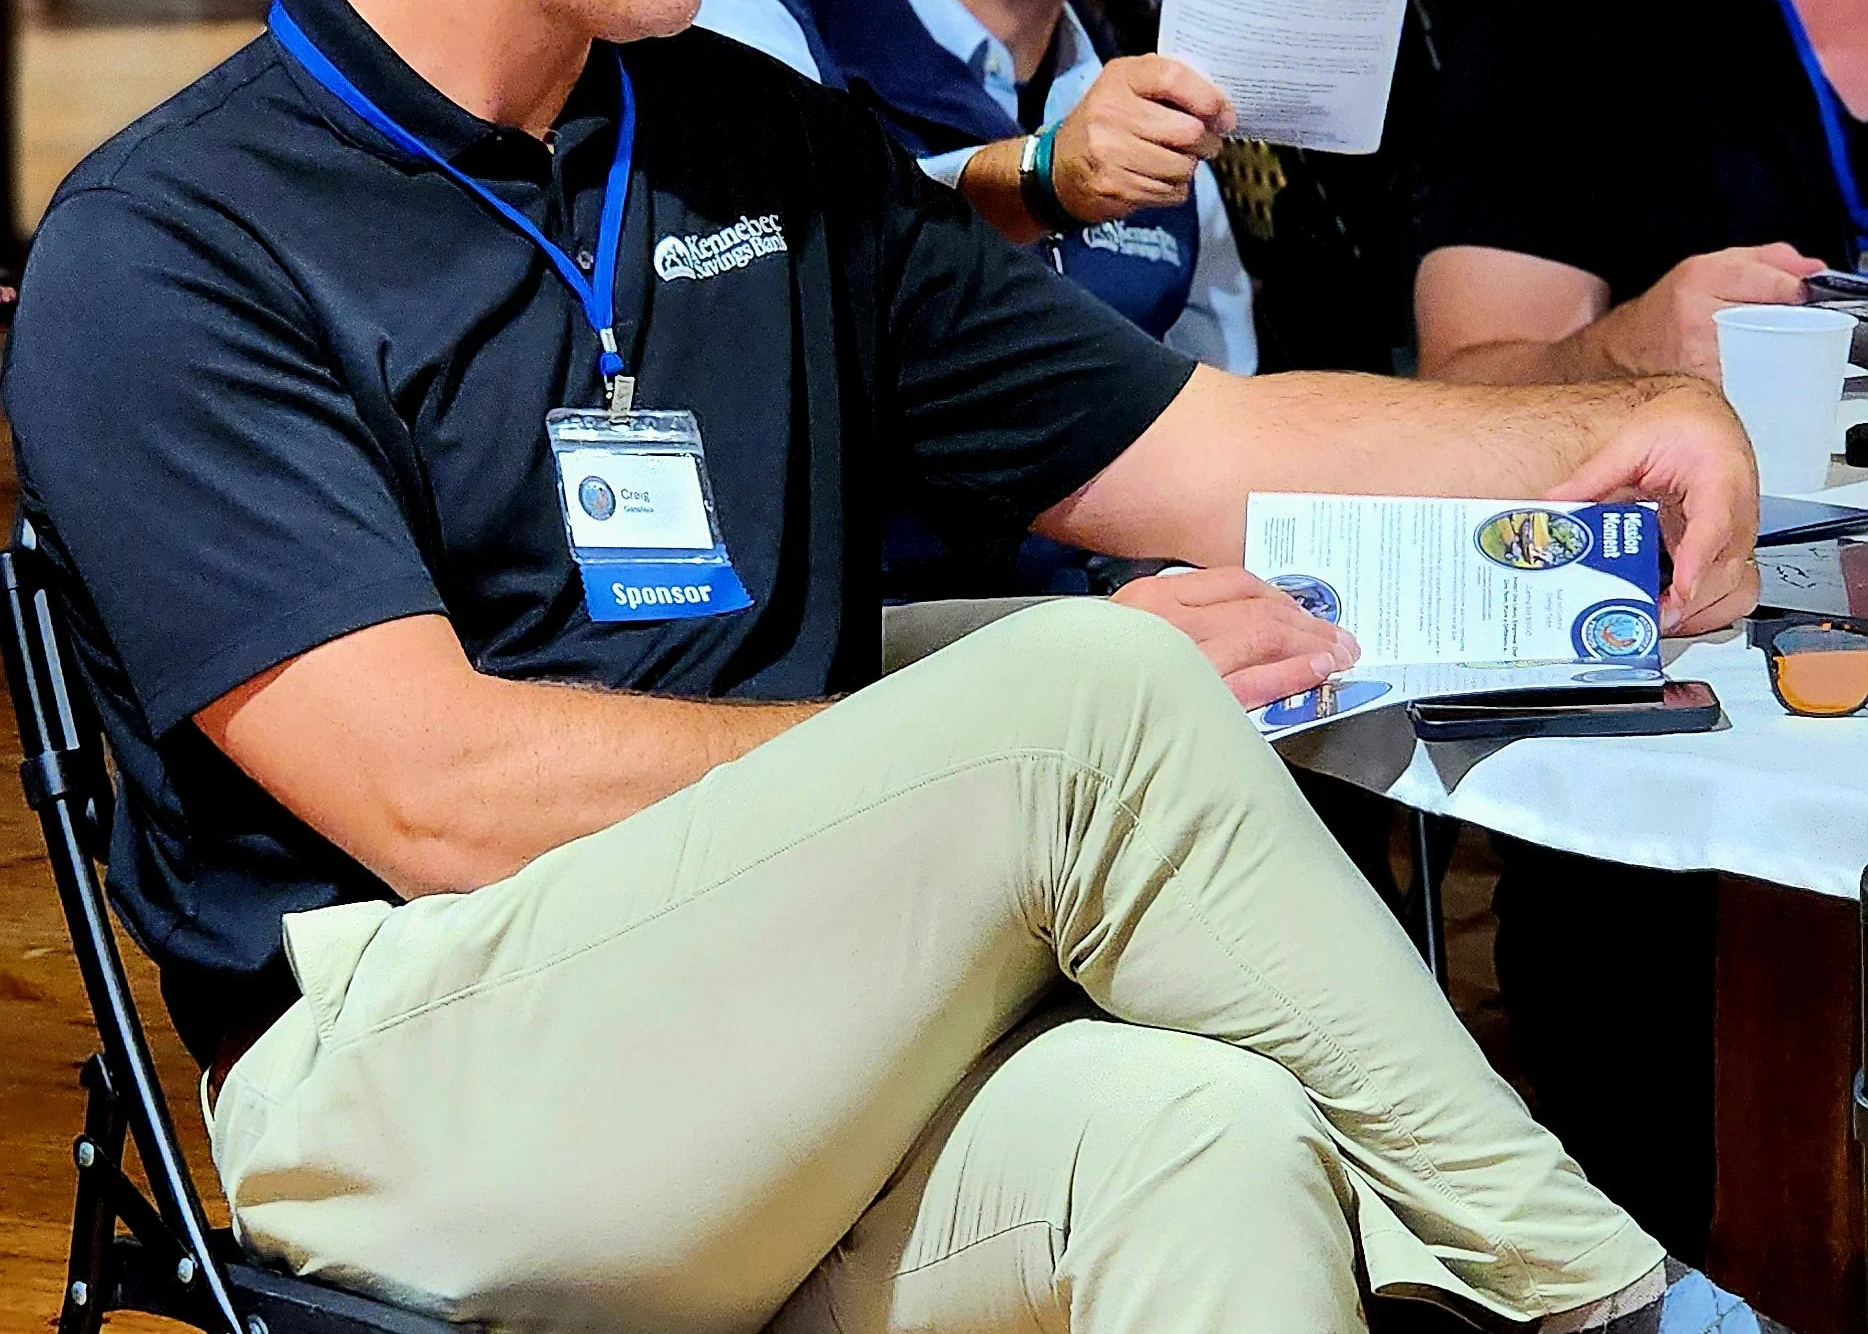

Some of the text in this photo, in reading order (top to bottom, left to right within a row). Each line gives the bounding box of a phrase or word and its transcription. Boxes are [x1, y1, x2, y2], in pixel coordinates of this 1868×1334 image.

[684, 214, 782, 260] Kennebec
[693, 242, 754, 279] Savings
[620, 488, 651, 503] Craig
[1602, 512, 1621, 558] Moment
[1623, 512, 1643, 554] Mission
[611, 582, 712, 610] Sponsor
